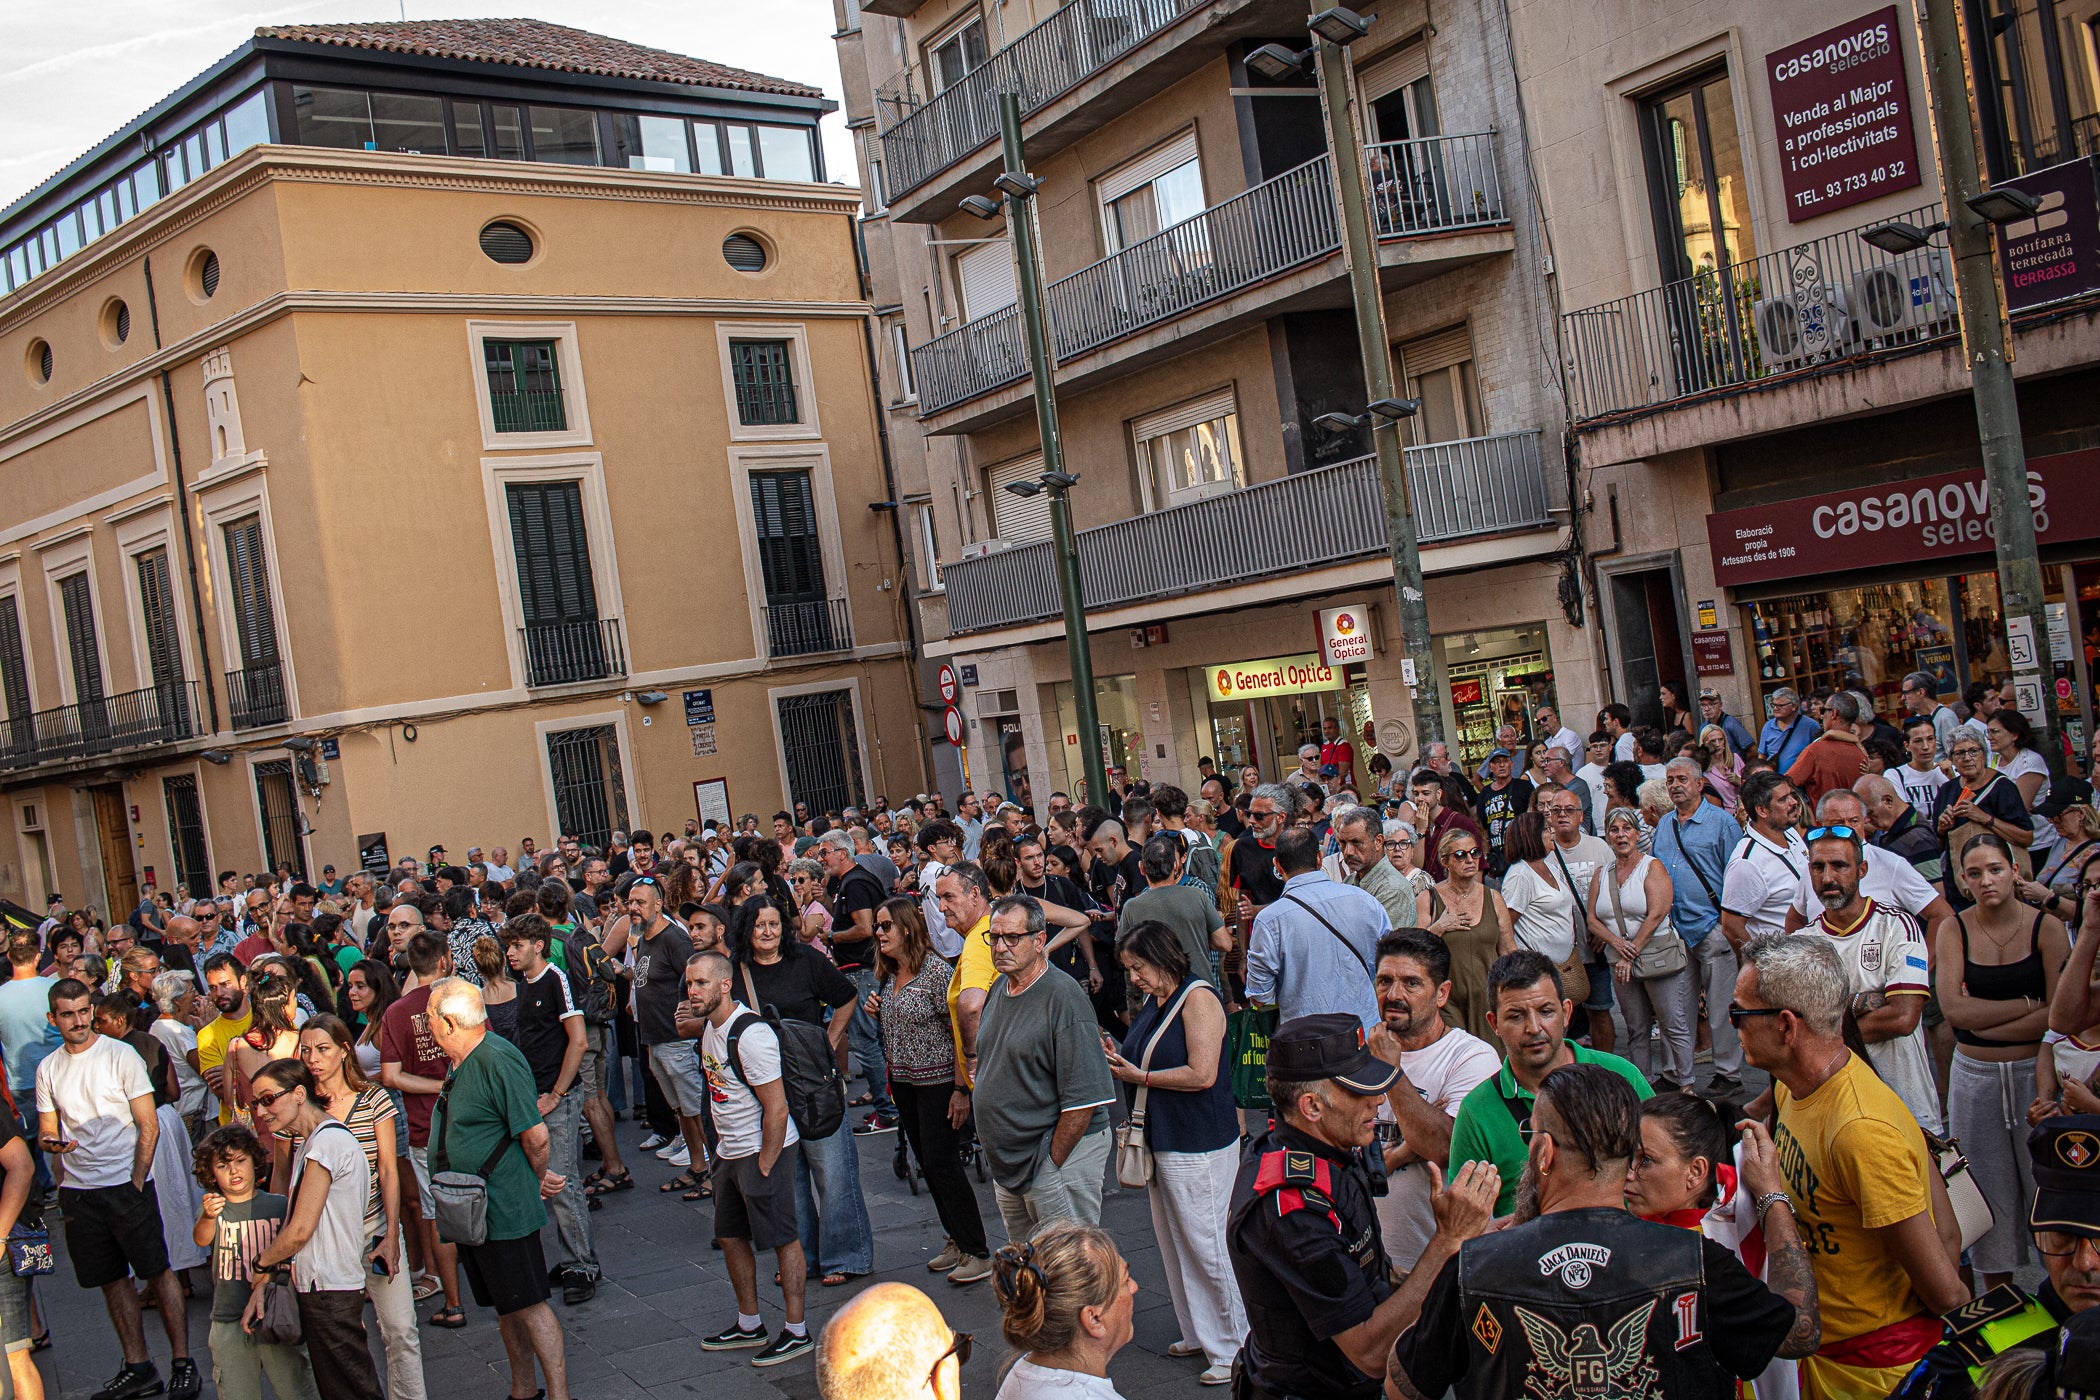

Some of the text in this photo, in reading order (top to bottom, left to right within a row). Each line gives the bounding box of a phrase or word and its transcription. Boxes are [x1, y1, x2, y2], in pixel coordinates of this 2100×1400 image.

[1775, 24, 1888, 81] casanovas
[1830, 40, 1890, 74] selecció
[1783, 79, 1893, 128] Venda al Major
[1785, 101, 1899, 151] a professionals
[1791, 125, 1898, 172] i col·lectivitats
[1794, 160, 1906, 207] TEL. 93 733 40 32
[1812, 471, 2046, 539] casanovs
[1735, 525, 1773, 539] Elaboració
[1721, 547, 1796, 567] Artesans des de 1906
[1744, 539, 1768, 552] propia
[1329, 633, 1368, 648] General
[1333, 646, 1366, 660] Optica
[1235, 661, 1332, 690] General Optica
[1250, 1033, 1264, 1048] The
[1242, 1050, 1252, 1065] of
[1541, 1246, 1608, 1272] JACK DANIEL'S
[1480, 1319, 1495, 1338] 13
[1576, 1360, 1605, 1384] FG
